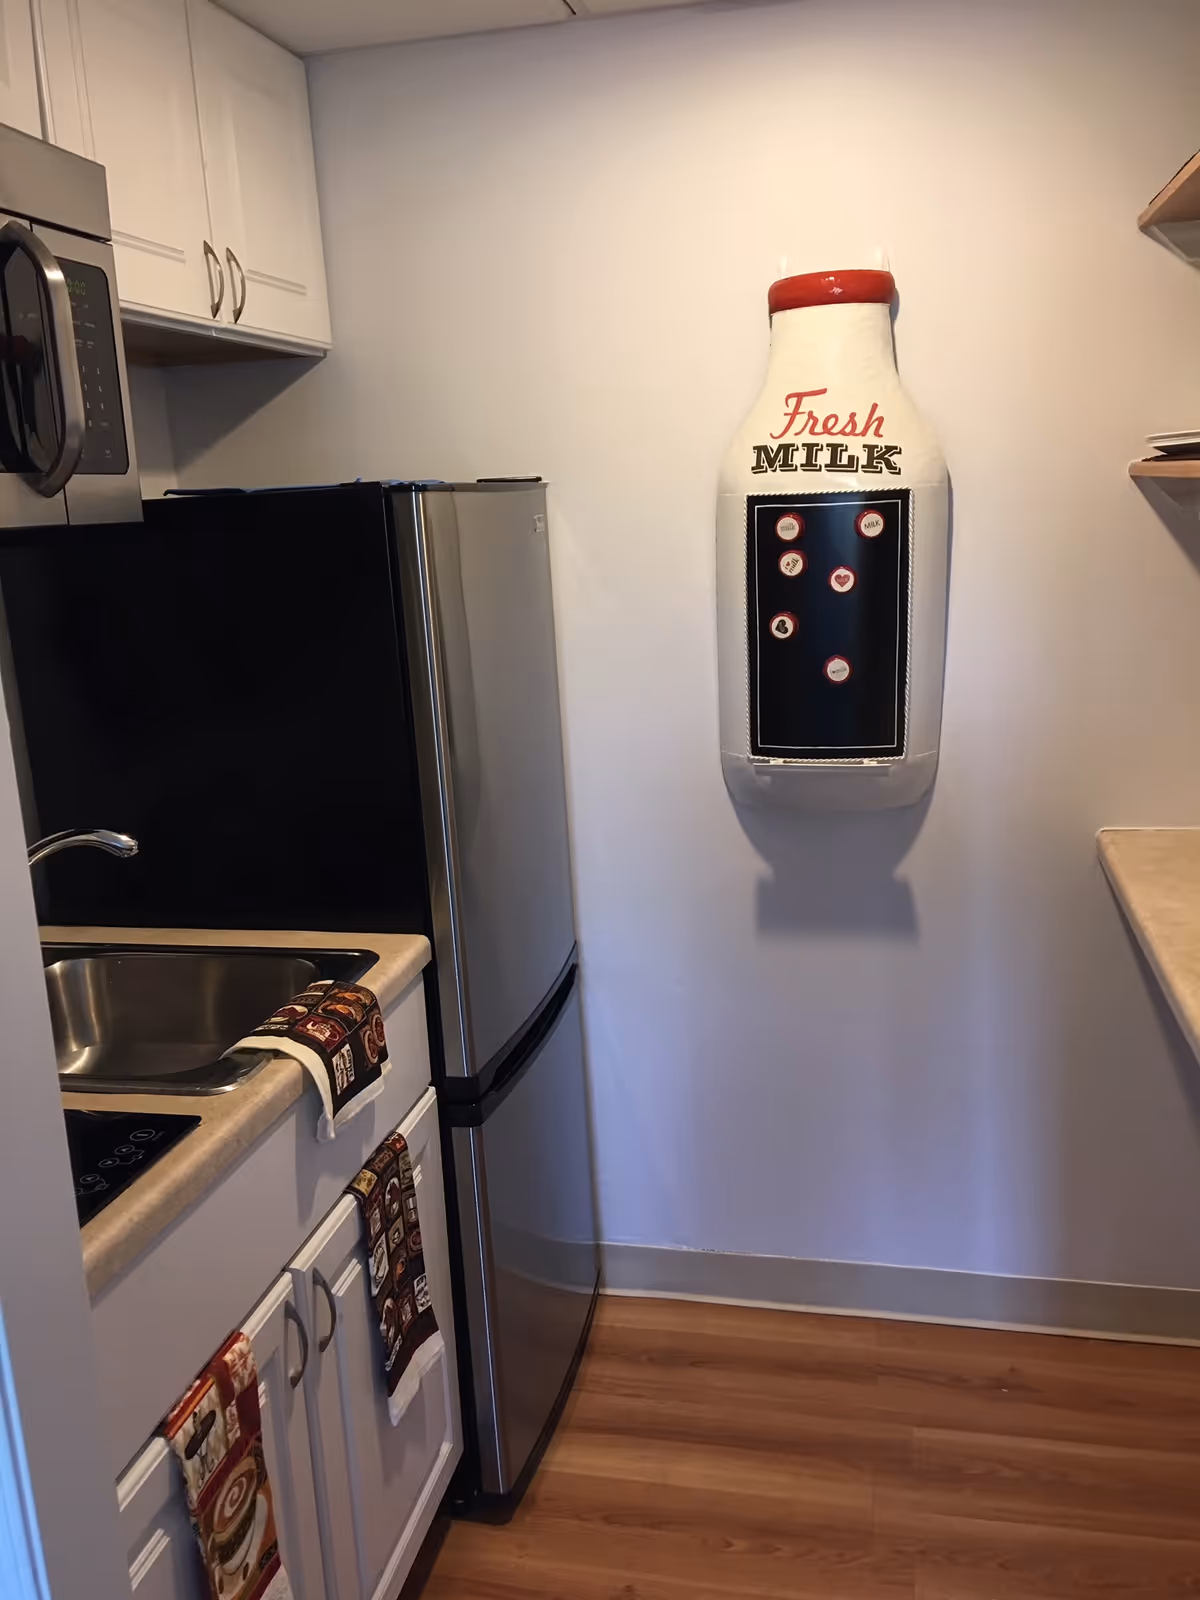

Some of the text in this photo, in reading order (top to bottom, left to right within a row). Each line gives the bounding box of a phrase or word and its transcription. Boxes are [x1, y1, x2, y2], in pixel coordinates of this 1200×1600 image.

[769, 388, 885, 439] Fresh
[751, 443, 902, 475] MILK
[864, 520, 881, 530] MILK
